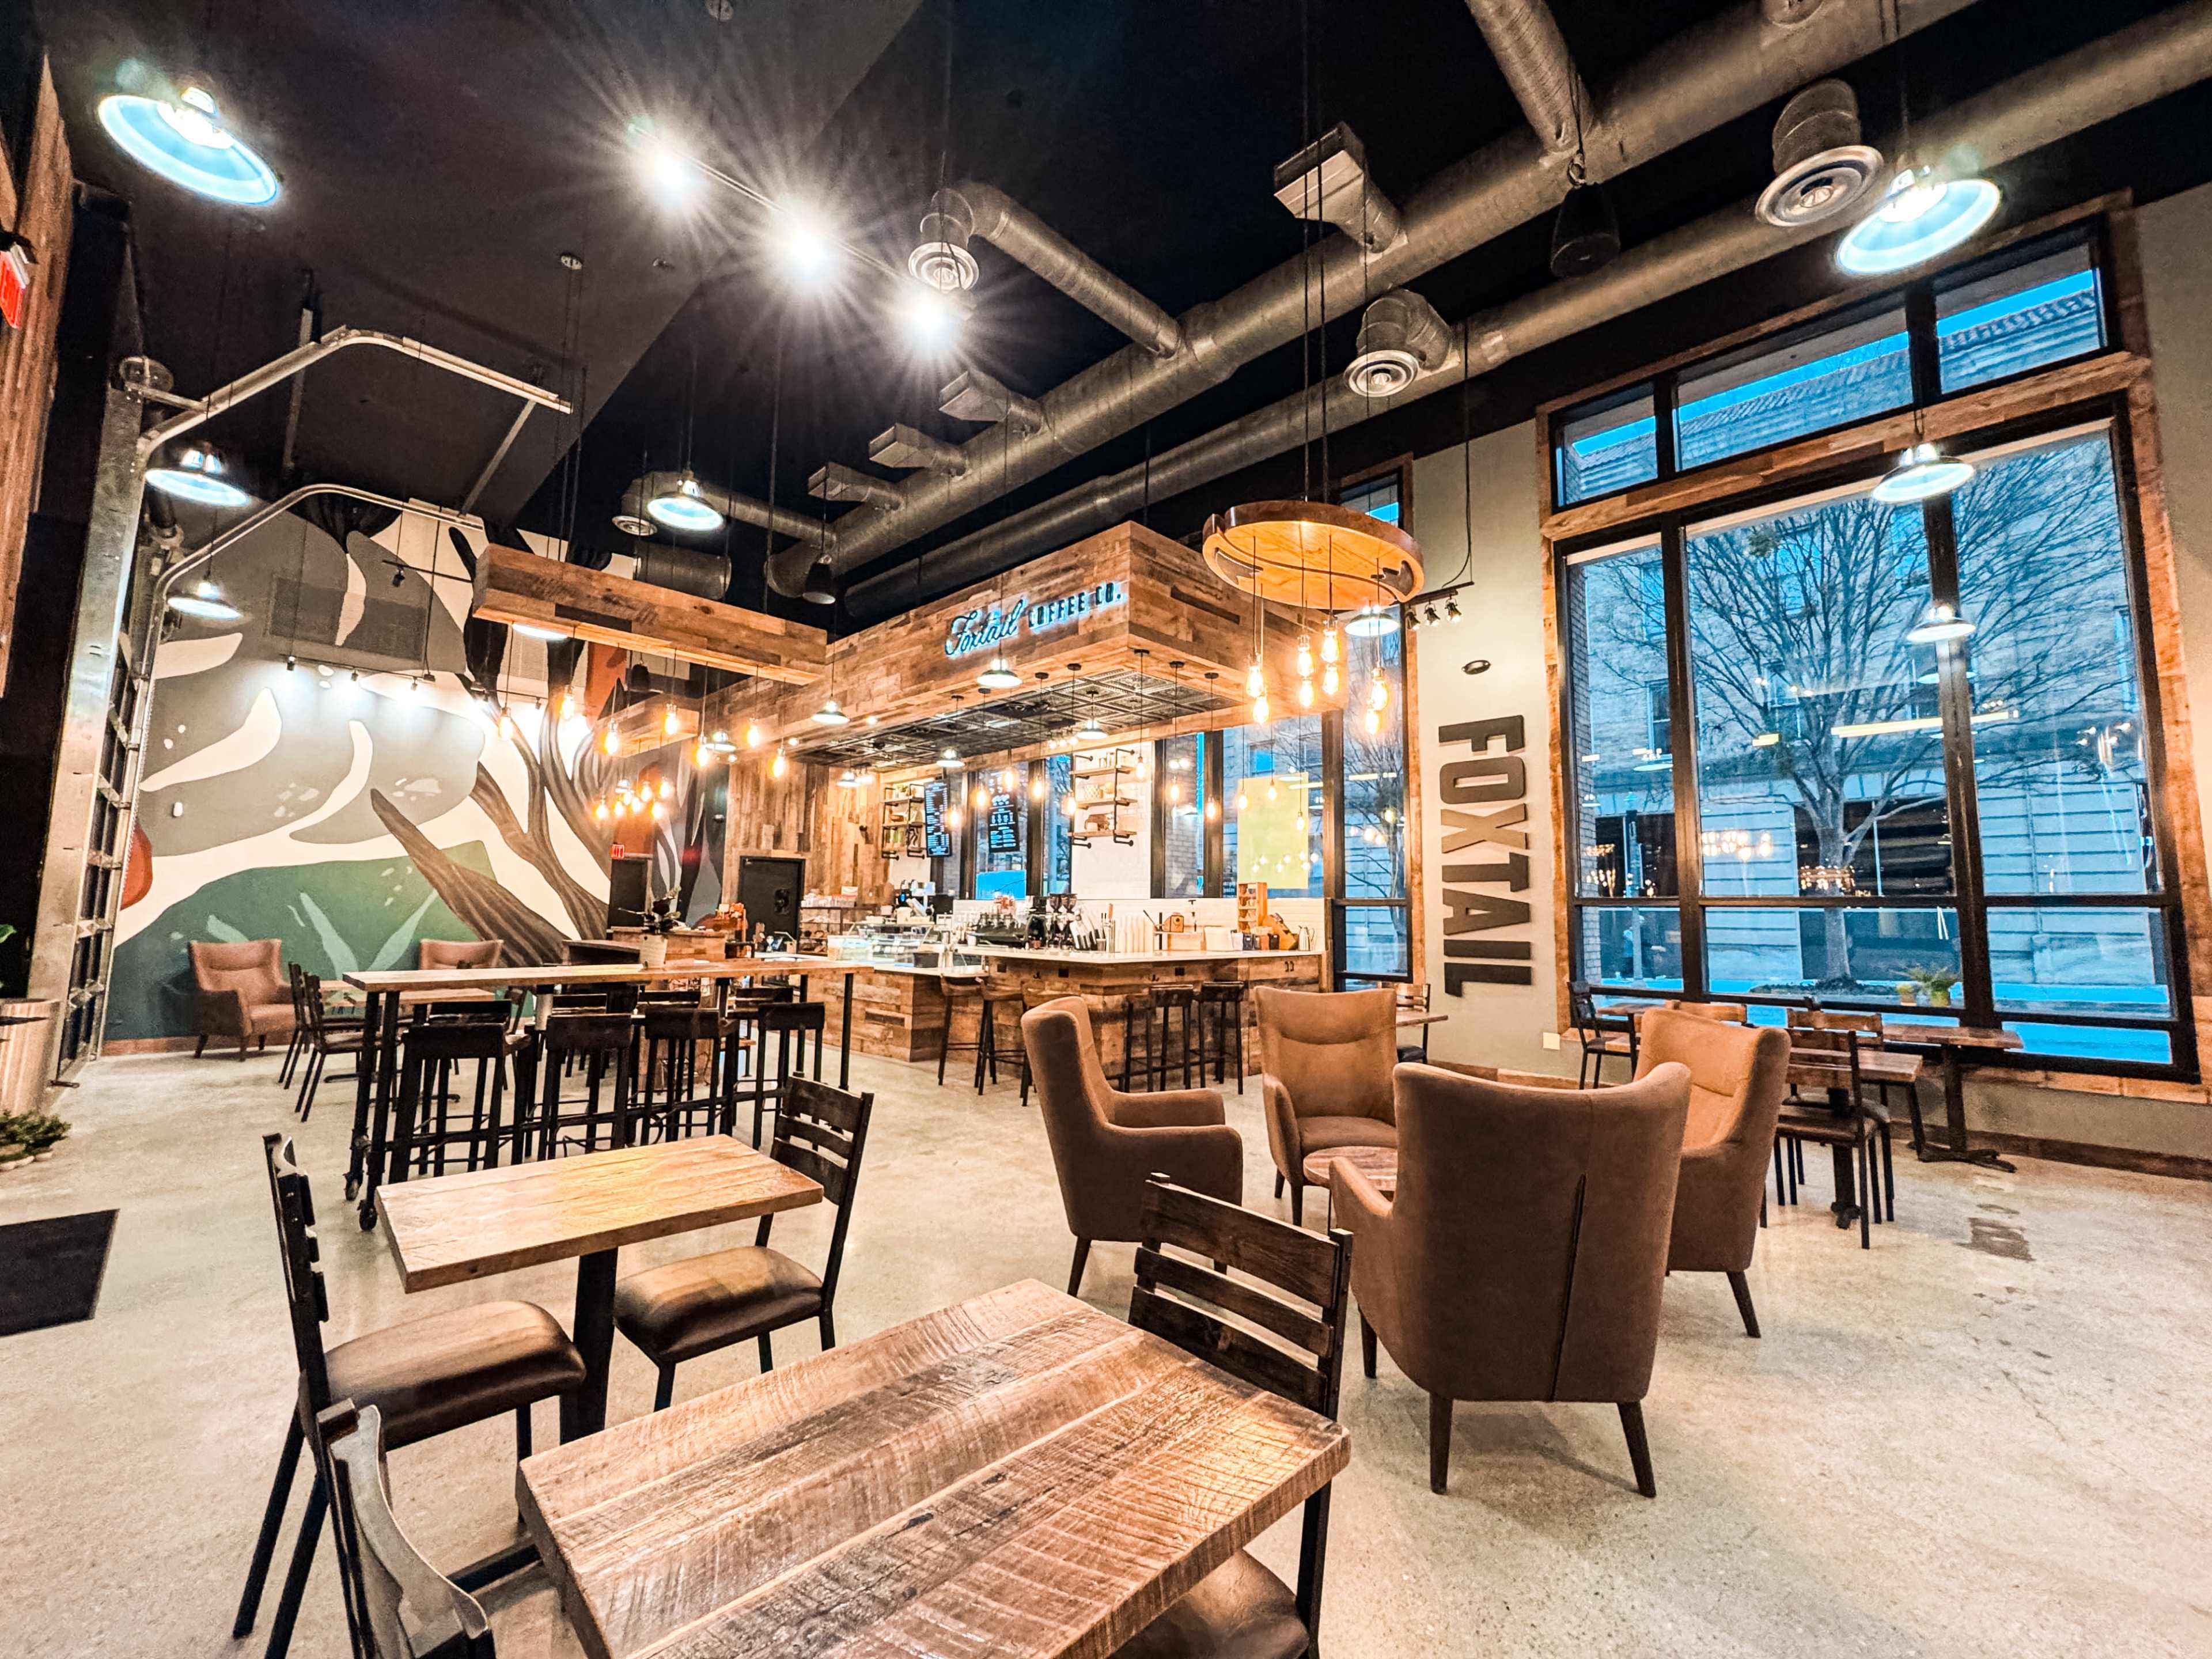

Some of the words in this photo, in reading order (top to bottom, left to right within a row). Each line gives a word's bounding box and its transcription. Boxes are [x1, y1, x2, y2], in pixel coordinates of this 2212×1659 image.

[945, 599, 1023, 655] Foxtail
[1028, 592, 1085, 627] COFFEE
[1096, 582, 1121, 605] CO.
[1438, 714, 1532, 998] FOXTAIL
